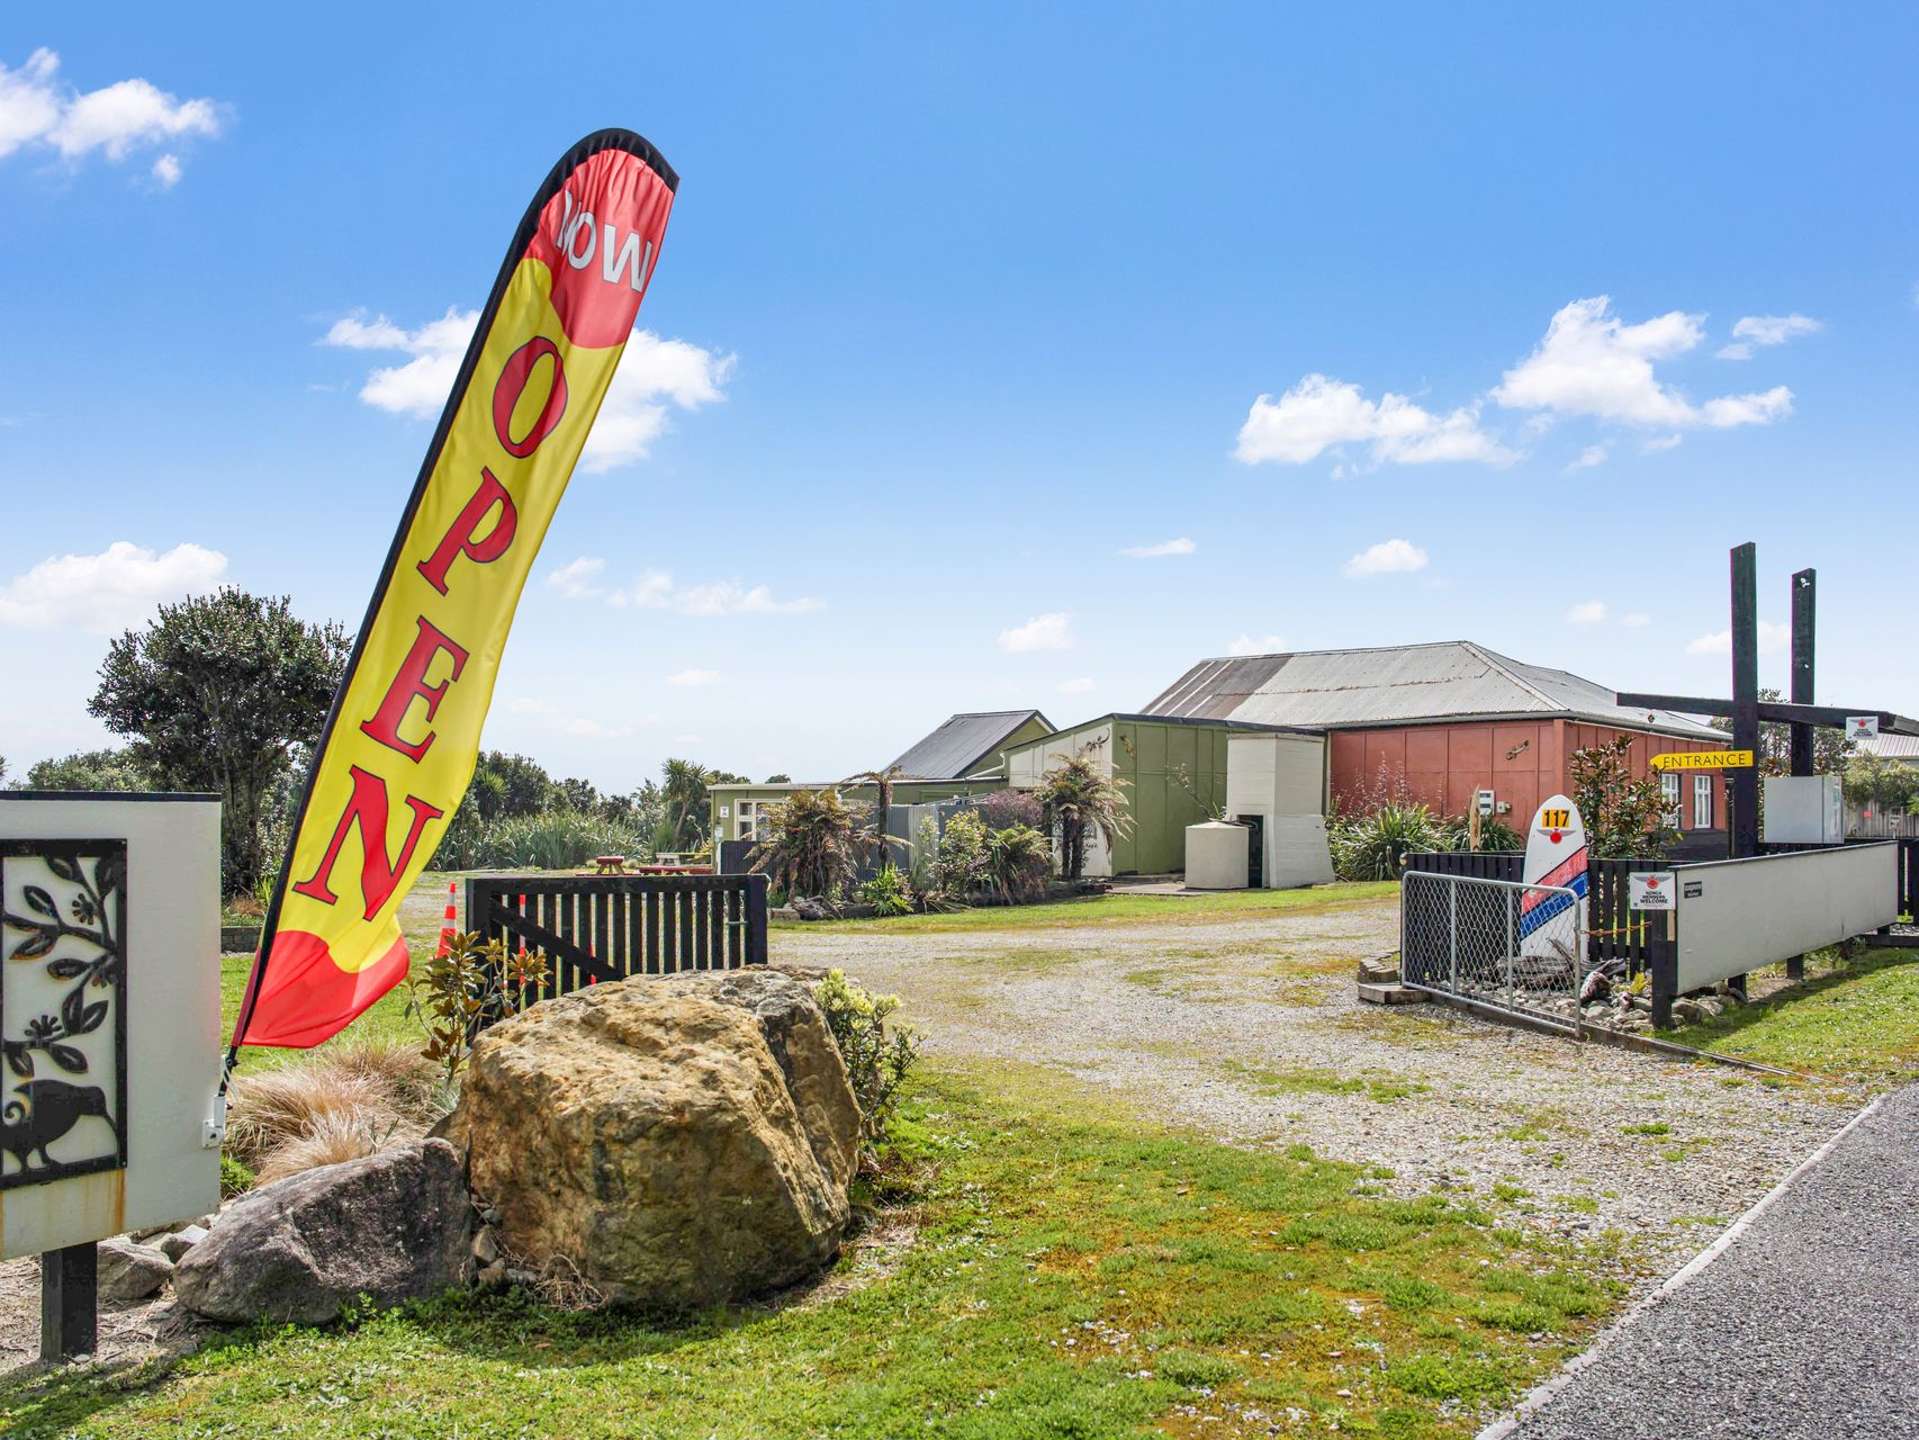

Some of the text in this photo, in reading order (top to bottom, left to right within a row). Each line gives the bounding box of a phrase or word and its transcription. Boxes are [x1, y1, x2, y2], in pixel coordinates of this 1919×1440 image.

[292, 335, 568, 922] OPEN
[1663, 753, 1745, 768] ENTRANCE
[1544, 810, 1570, 828] 117
